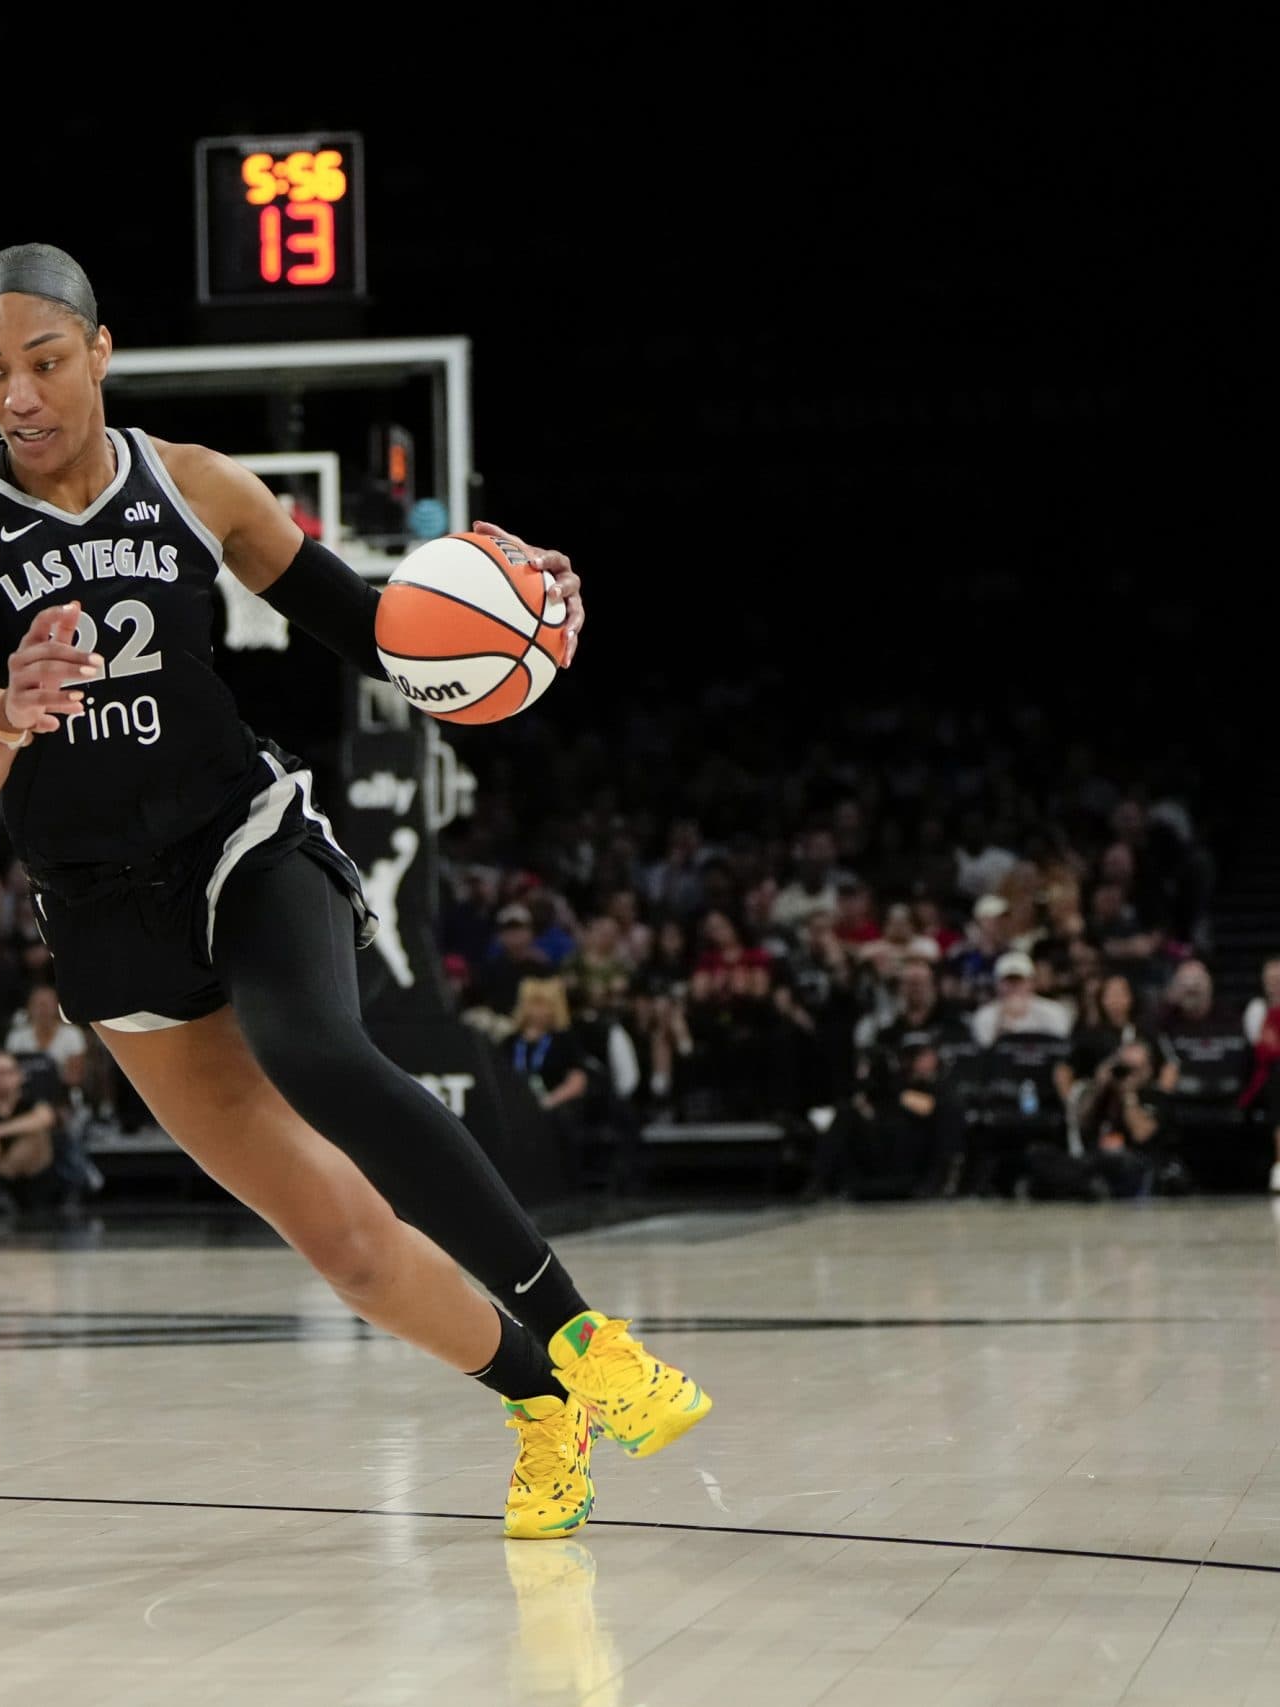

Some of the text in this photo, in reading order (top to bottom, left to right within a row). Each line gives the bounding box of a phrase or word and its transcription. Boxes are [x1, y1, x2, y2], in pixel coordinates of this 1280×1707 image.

[241, 150, 347, 205] 5:56
[259, 201, 336, 285] 13
[124, 501, 161, 524] ally
[69, 538, 179, 583] VEGAS
[386, 671, 471, 702] ilson
[66, 695, 161, 745] ring
